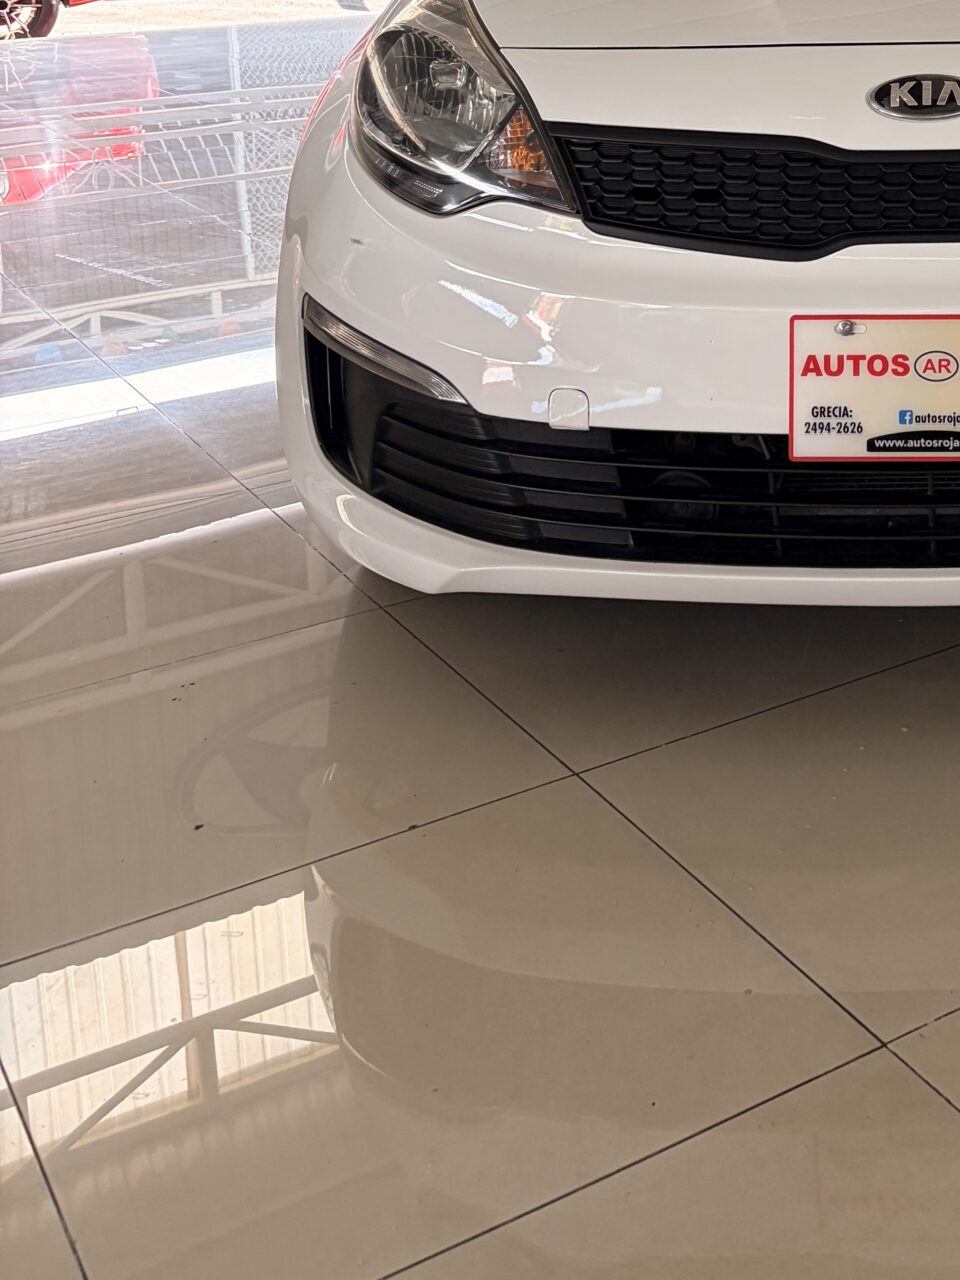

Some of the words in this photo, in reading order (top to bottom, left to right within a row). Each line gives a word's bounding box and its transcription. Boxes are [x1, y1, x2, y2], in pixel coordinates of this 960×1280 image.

[800, 353, 911, 378] AUTOS
[922, 358, 952, 374] AR
[811, 405, 853, 419] GRECIA:
[804, 421, 863, 434] 2494-2626
